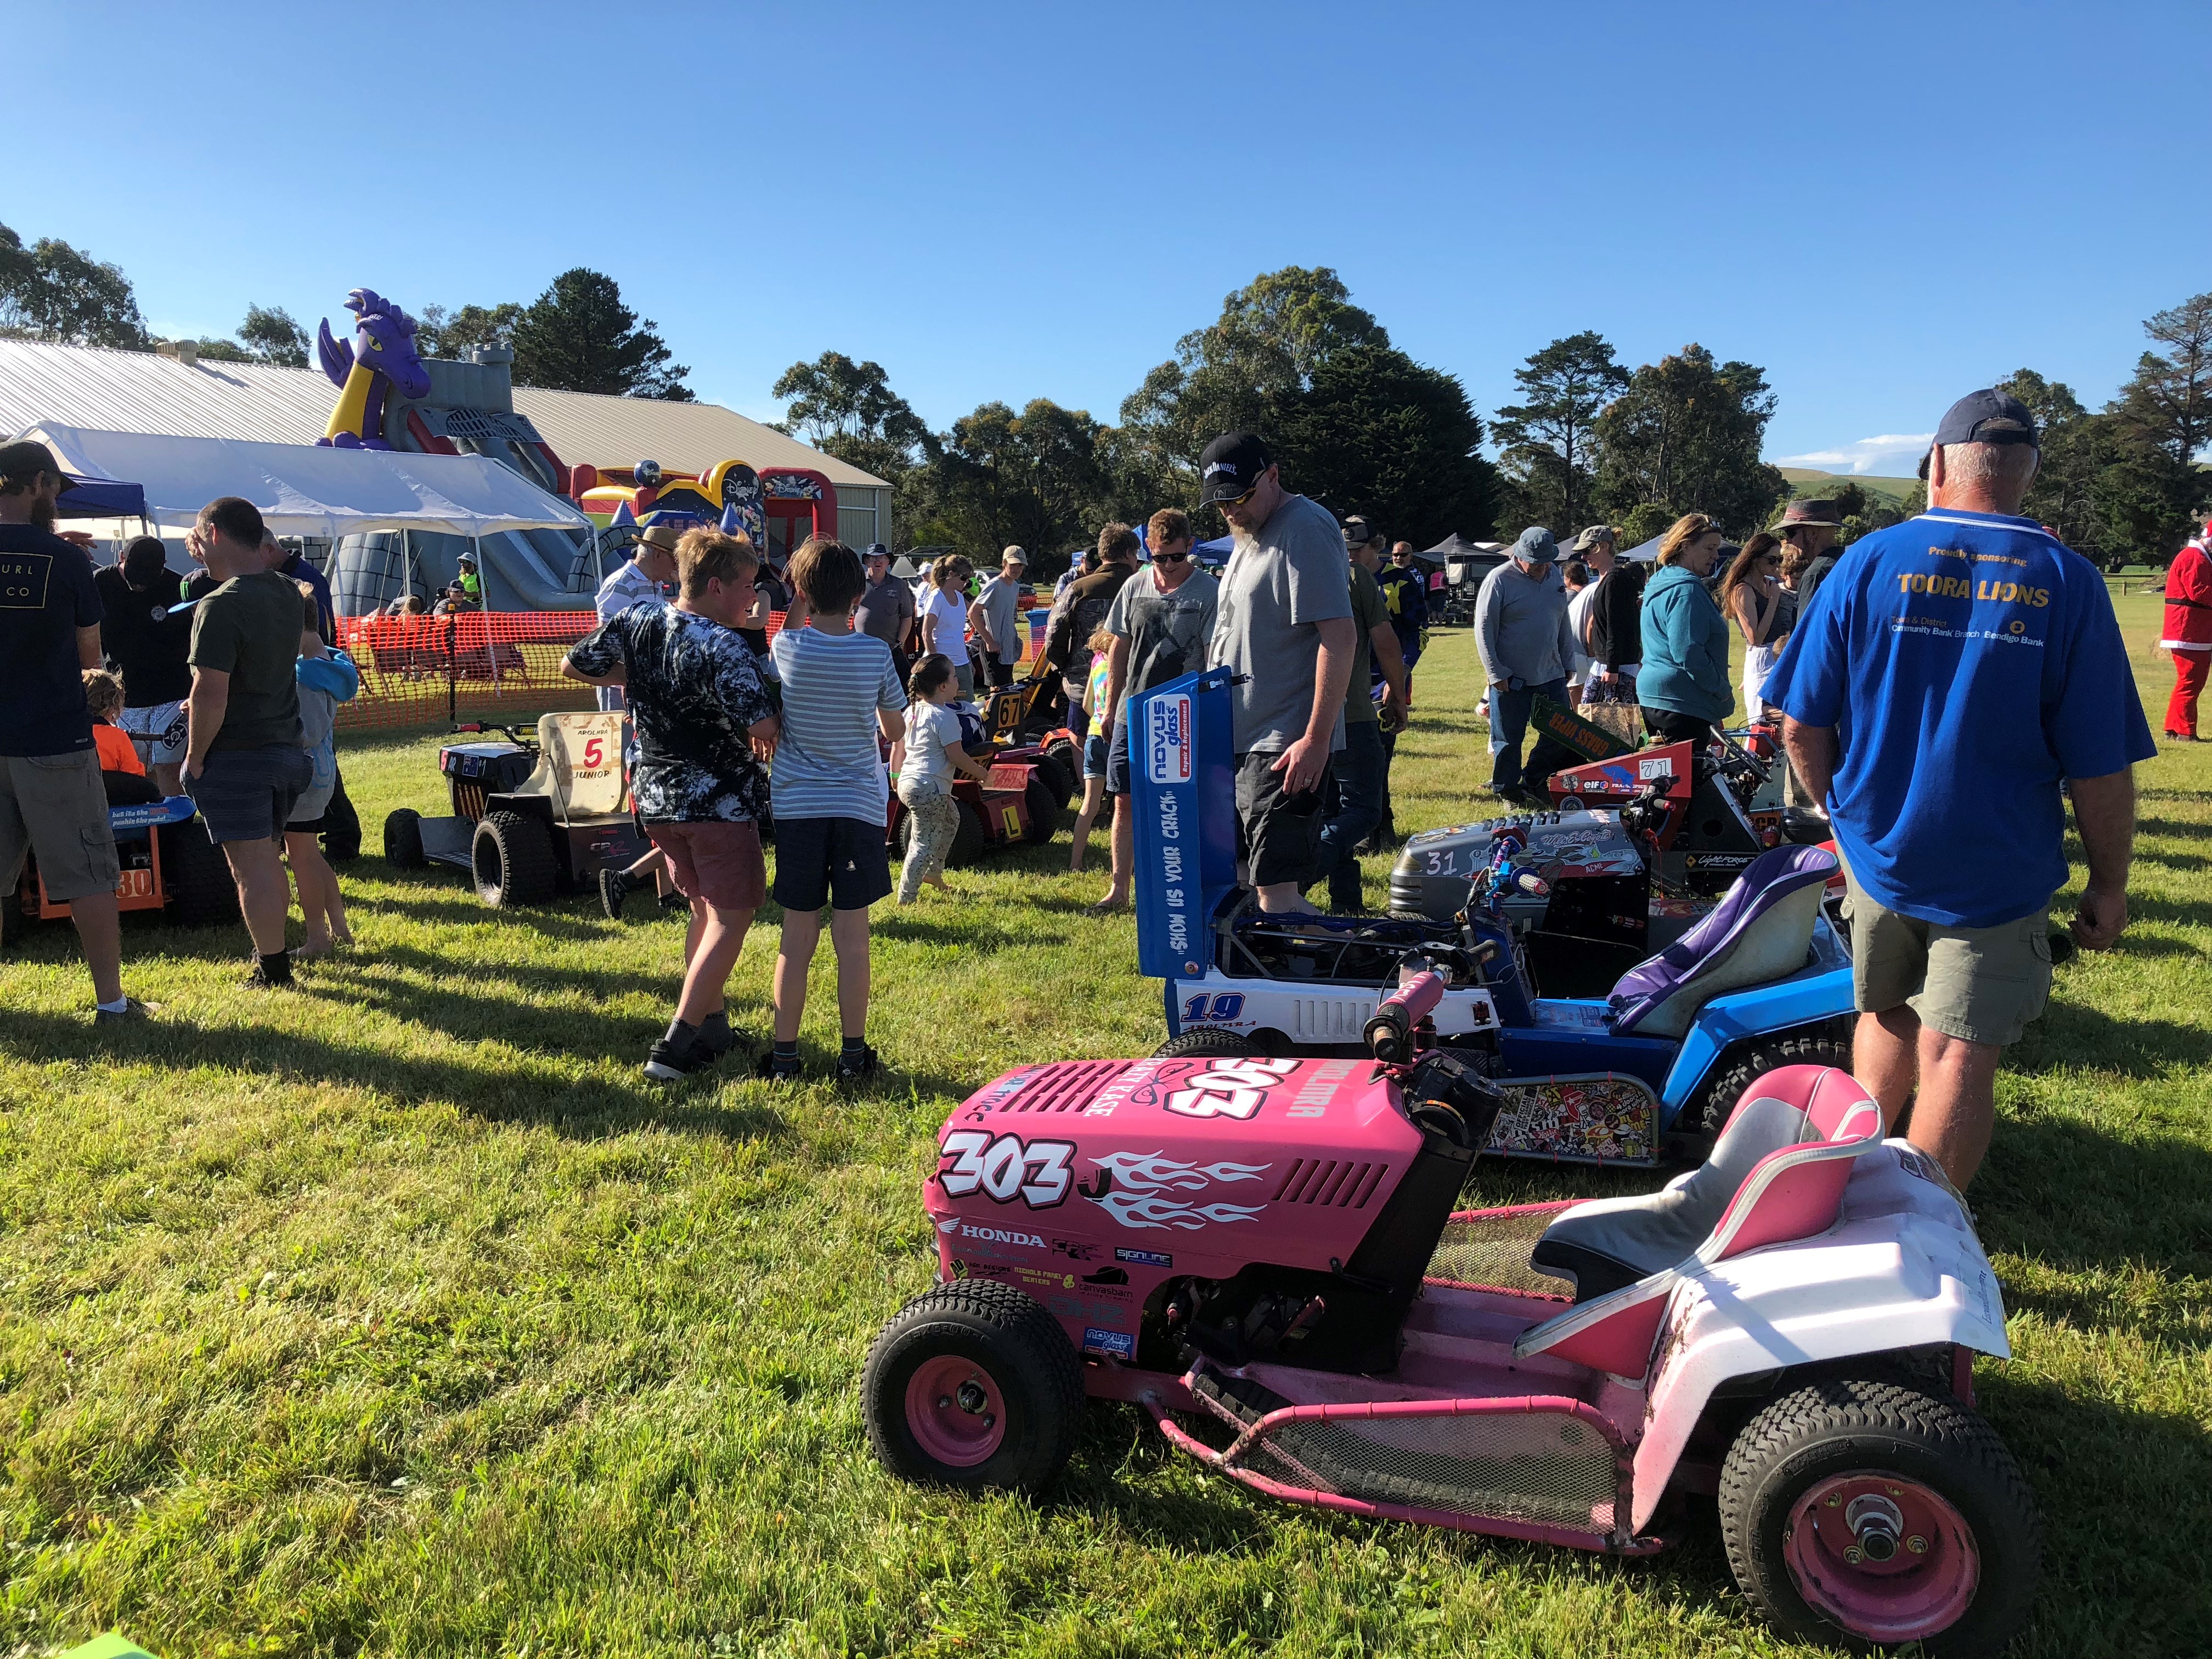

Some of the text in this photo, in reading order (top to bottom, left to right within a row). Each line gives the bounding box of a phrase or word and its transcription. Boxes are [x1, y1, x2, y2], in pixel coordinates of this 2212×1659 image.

[1928, 546, 2027, 567] Proudly sponsoring
[6, 586, 30, 597] CO
[1898, 573, 2050, 607] TOORA LIONS
[1921, 617, 1947, 628] District
[1932, 628, 1953, 637] Bank
[1954, 630, 1980, 639] Branch
[1984, 631, 2019, 644] Bendigo
[2021, 636, 2044, 647] Bank
[1000, 698, 1020, 726] 67
[1164, 707, 1182, 746] glass
[440, 750, 448, 771] 5
[584, 738, 603, 768] 5
[573, 770, 610, 779] JUNIOR
[1641, 760, 1669, 778] 71
[1584, 781, 1600, 789] elf
[1005, 811, 1019, 835] L
[1579, 829, 1612, 847] Coyote
[1163, 846, 1183, 883] YOUR
[1426, 851, 1458, 876] 31
[1585, 862, 1604, 873] ACME
[1165, 888, 1184, 907] US
[1180, 992, 1246, 1023] 19
[1083, 1085, 1135, 1117] KASE
[1515, 1097, 1528, 1127] OFFICIAL
[938, 1128, 1077, 1211] 303
[961, 1224, 1047, 1248] HONDA
[1117, 1249, 1170, 1263] SIGNLINE
[1014, 1267, 1063, 1279] NICHOLS PANEL
[1079, 1284, 1133, 1298] canvasbarn
